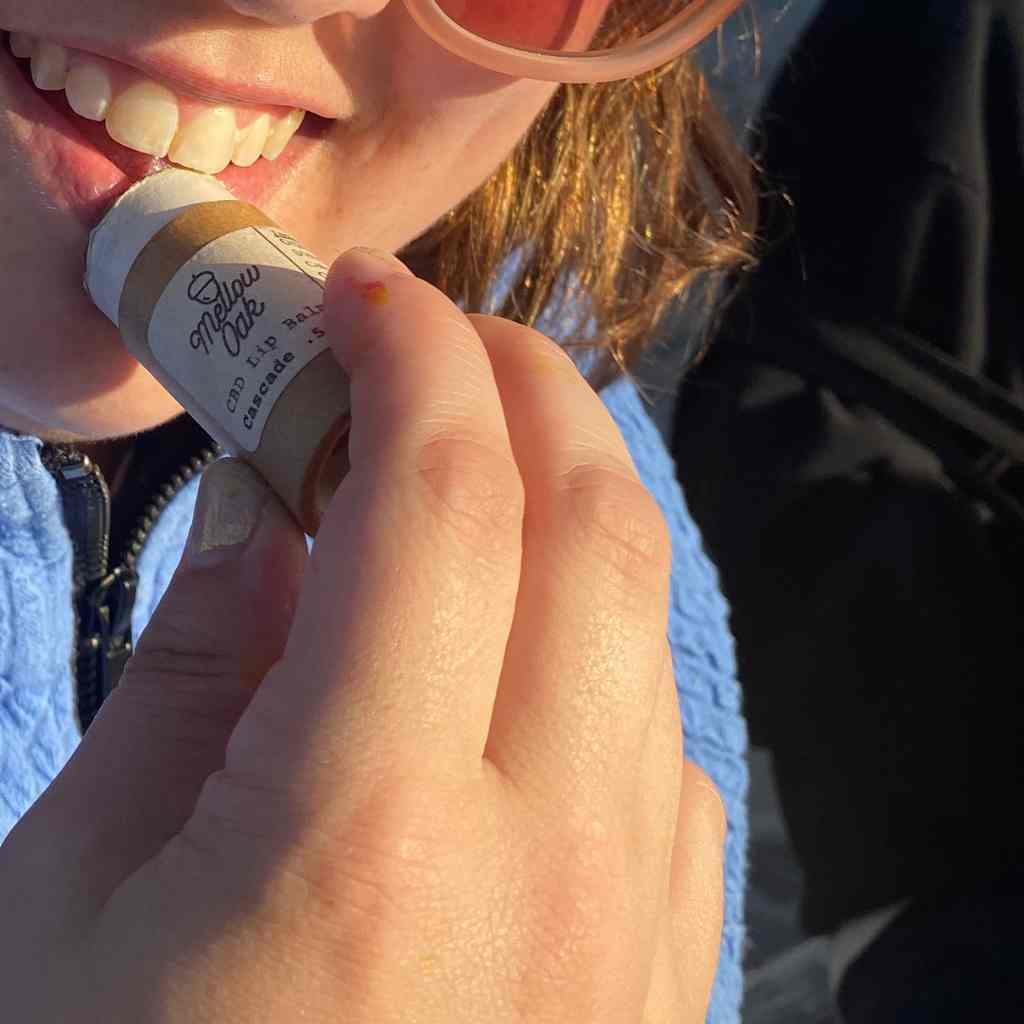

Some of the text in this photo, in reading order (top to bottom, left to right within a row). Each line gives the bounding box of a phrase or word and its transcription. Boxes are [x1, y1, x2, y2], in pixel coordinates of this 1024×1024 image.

[189, 265, 261, 354] Mellow
[222, 296, 265, 357] Oak
[245, 335, 278, 369] Lip
